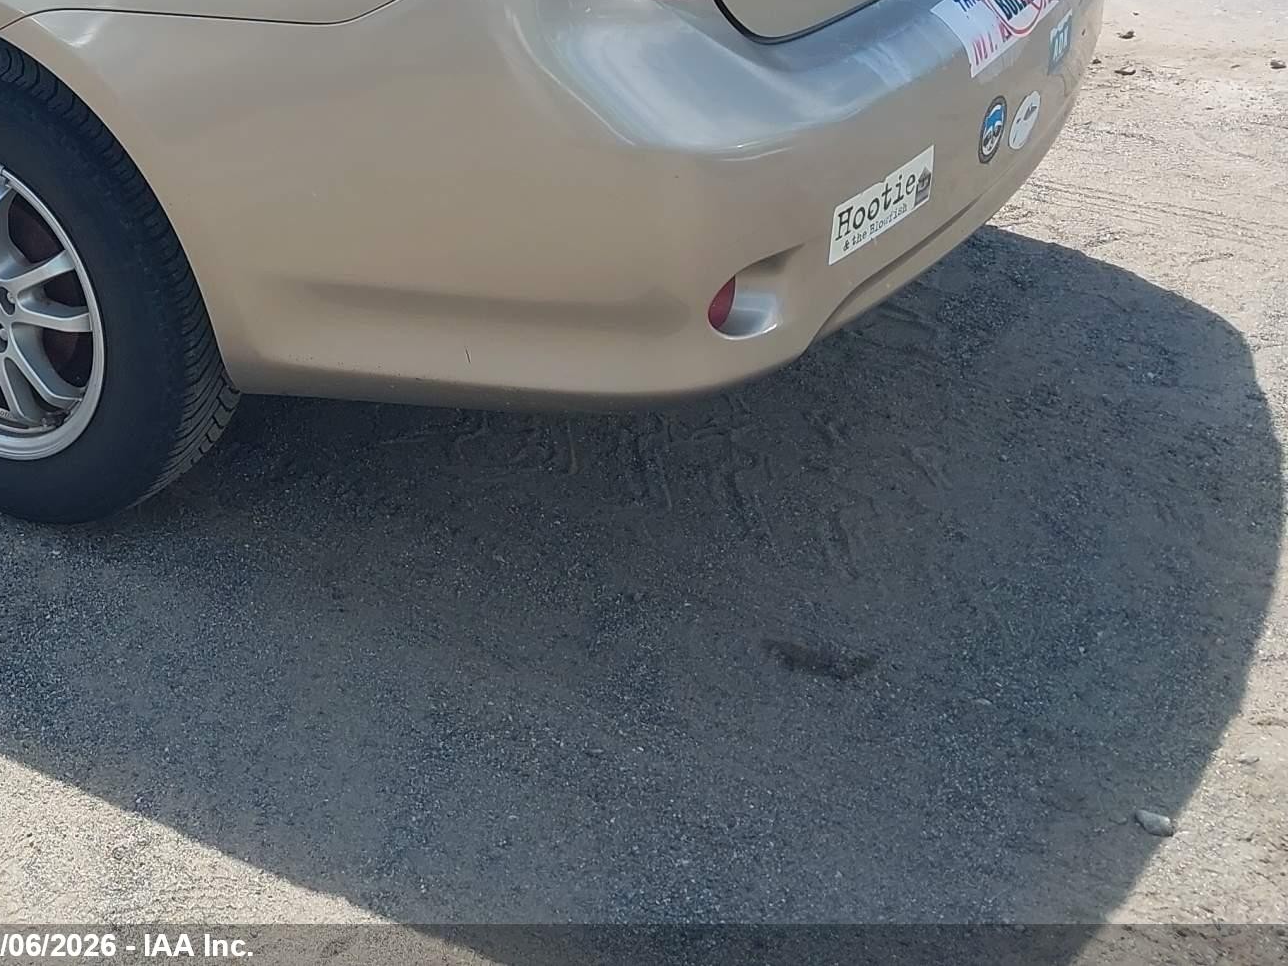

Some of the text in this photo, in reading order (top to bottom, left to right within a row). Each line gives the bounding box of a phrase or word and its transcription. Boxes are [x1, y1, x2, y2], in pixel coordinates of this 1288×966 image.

[835, 174, 916, 241] Hootie
[852, 230, 867, 246] the
[869, 203, 908, 236] Blowfish
